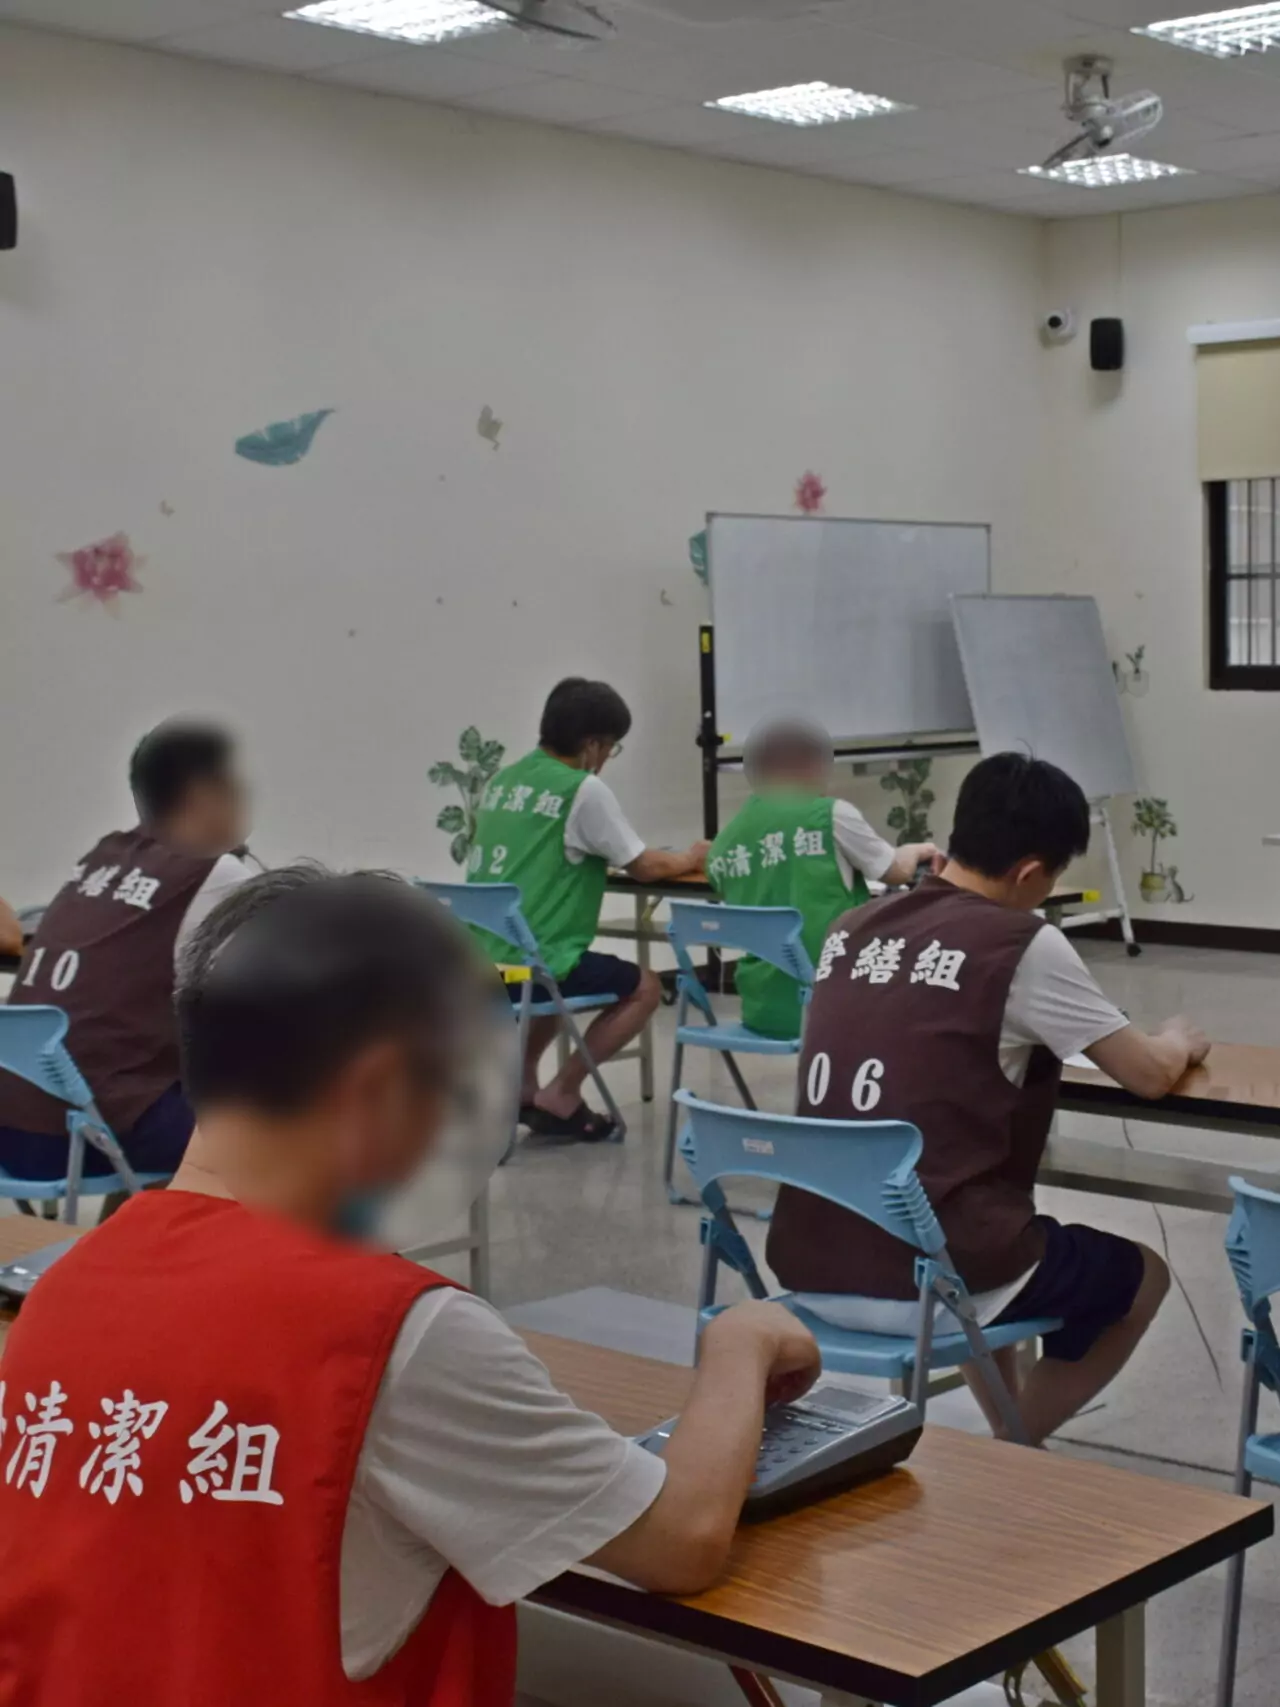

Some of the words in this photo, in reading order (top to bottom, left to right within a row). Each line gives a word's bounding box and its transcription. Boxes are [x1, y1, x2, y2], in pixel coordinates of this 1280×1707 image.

[22, 947, 79, 991] 10
[815, 930, 966, 991] 營繕組
[807, 1052, 885, 1111] 06
[0, 1380, 284, 1505] 清潔組
